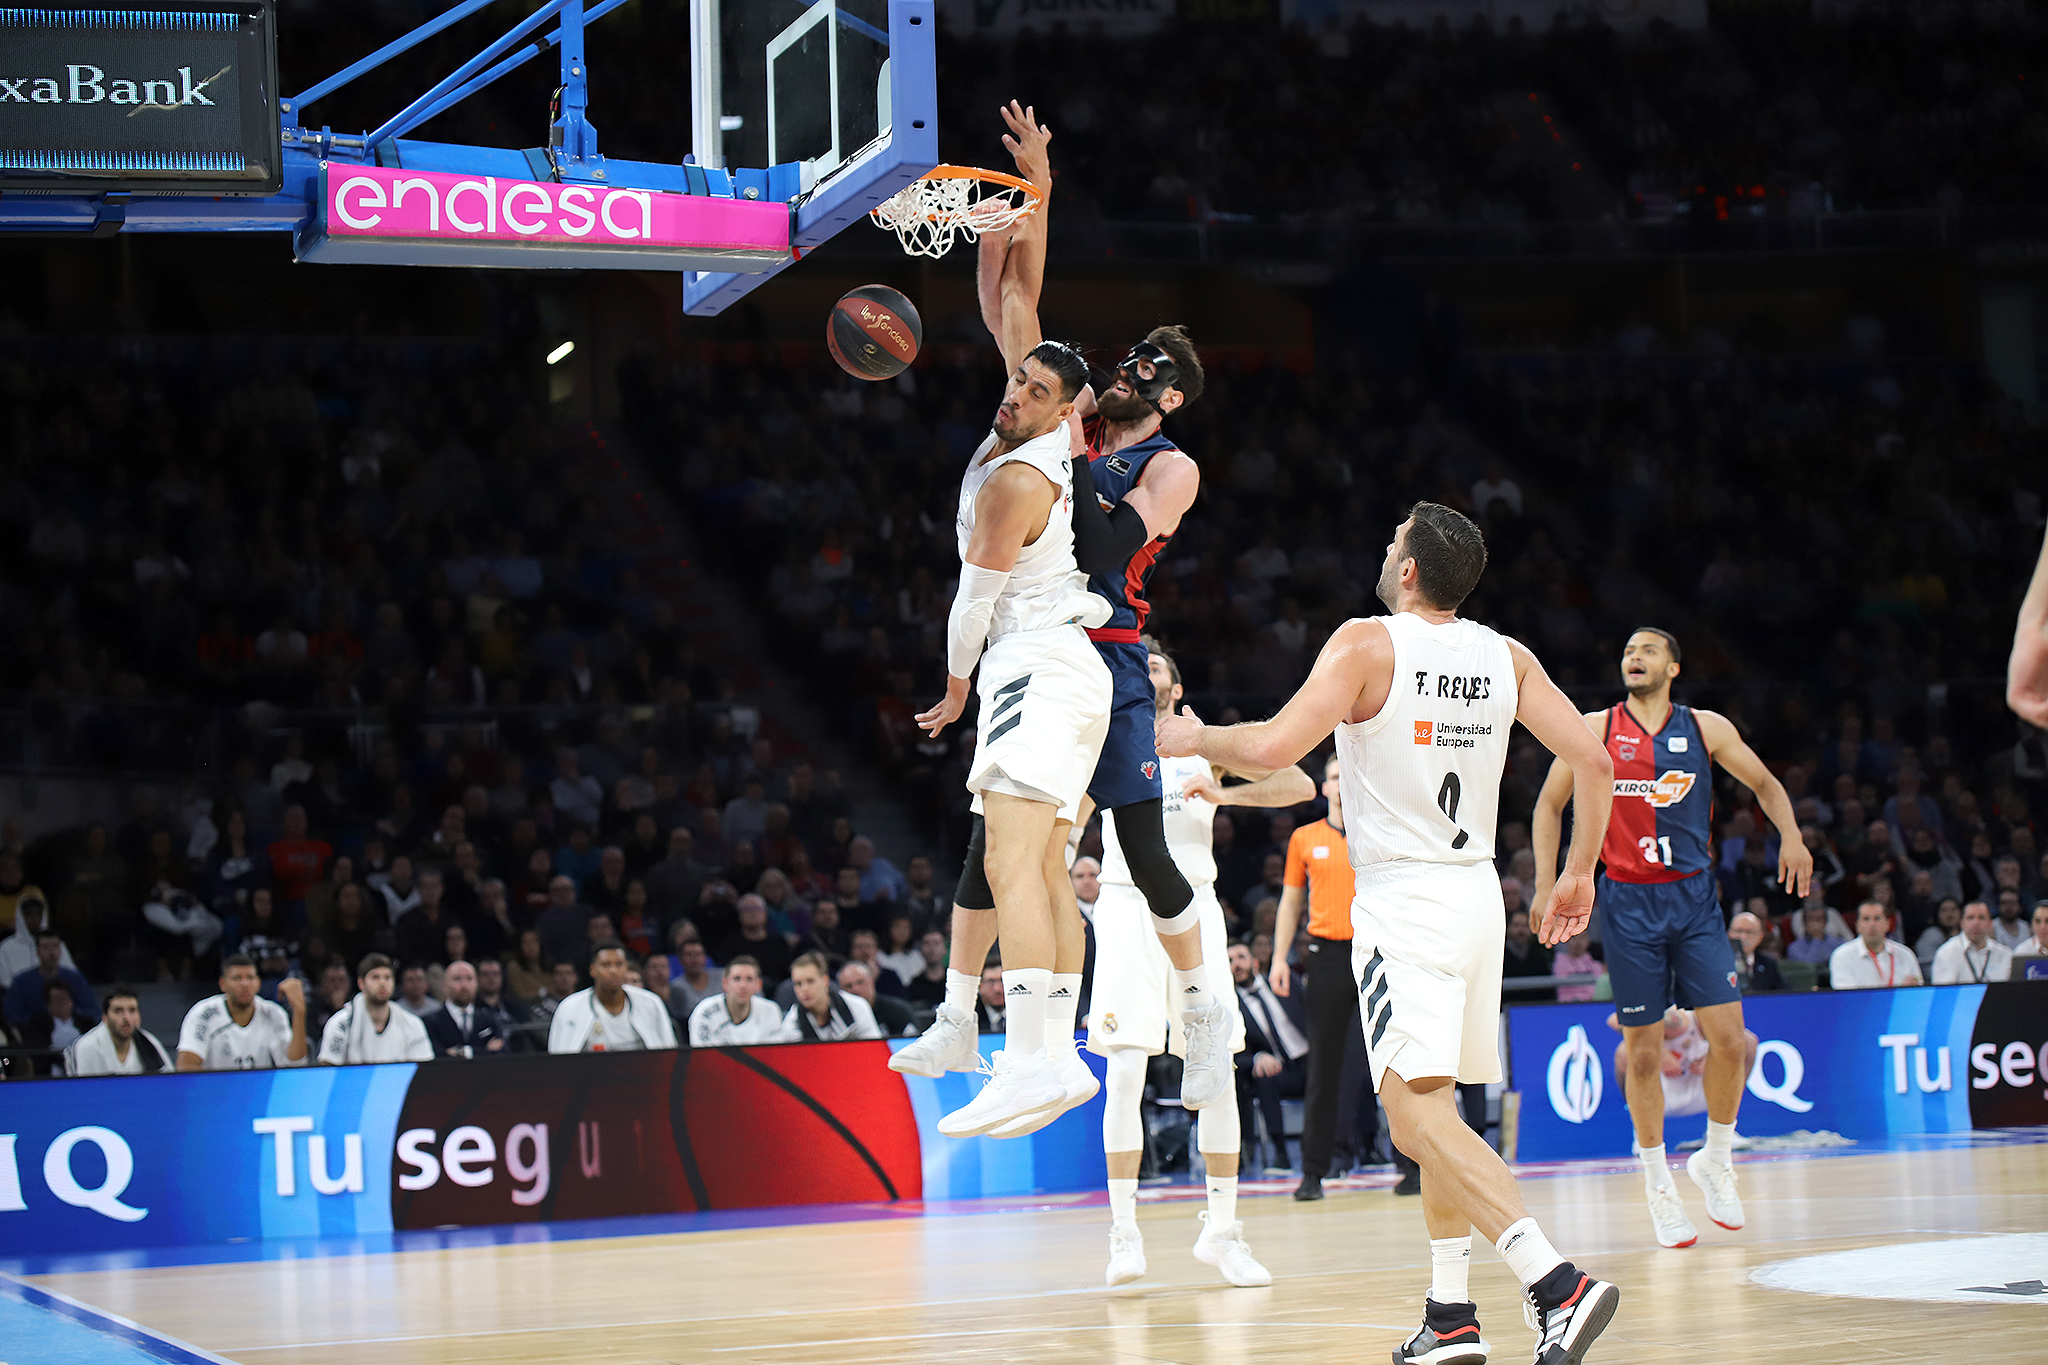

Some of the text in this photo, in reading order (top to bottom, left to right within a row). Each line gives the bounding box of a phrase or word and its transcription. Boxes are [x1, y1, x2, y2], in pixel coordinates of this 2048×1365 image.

[0, 64, 216, 106] xaBank
[334, 176, 652, 239] endesa
[880, 320, 910, 353] endesa
[1415, 671, 1492, 707] F. REYES
[1436, 722, 1492, 736] Universidad
[1436, 736, 1475, 749] Europea
[1638, 836, 1673, 866] 31
[1879, 1033, 1952, 1094] Tu
[252, 1115, 363, 1197] Tu
